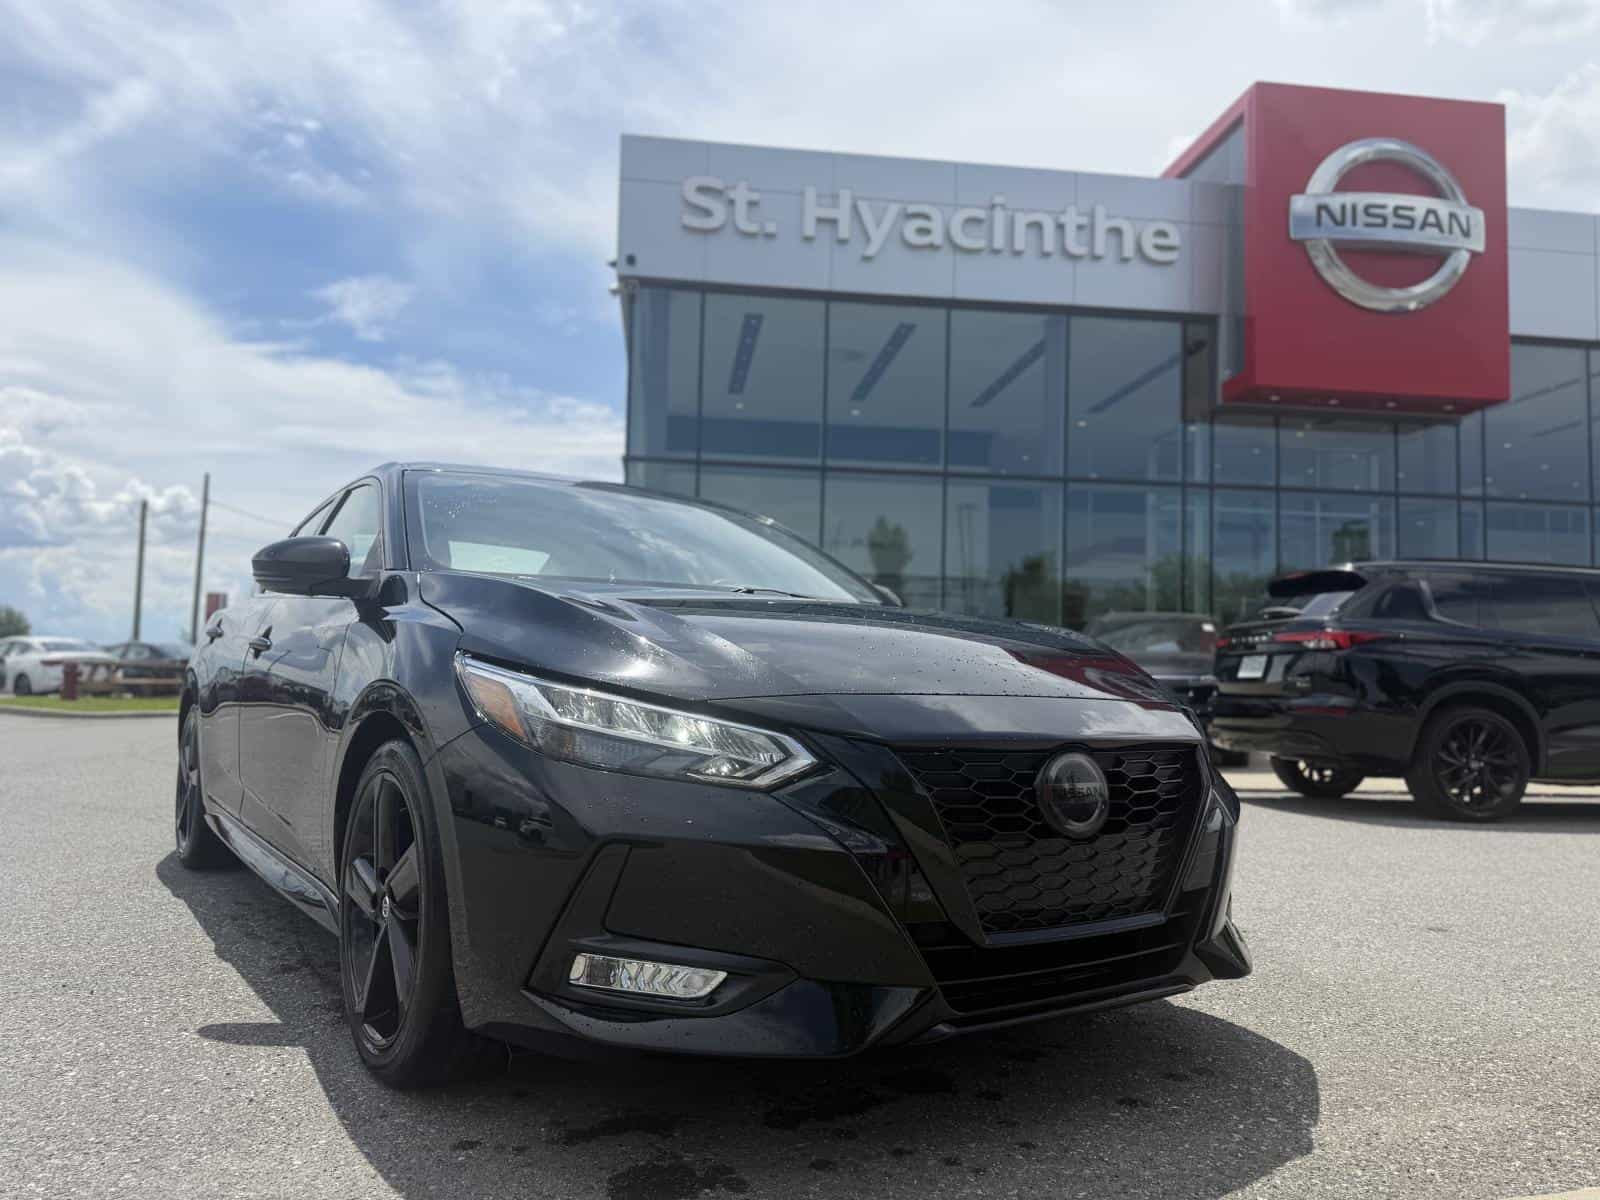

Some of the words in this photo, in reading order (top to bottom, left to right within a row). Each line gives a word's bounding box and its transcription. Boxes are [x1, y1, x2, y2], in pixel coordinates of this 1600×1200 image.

[680, 176, 777, 238] St.
[802, 185, 1182, 265] Hyacinthe
[1315, 202, 1472, 239] NISSAN
